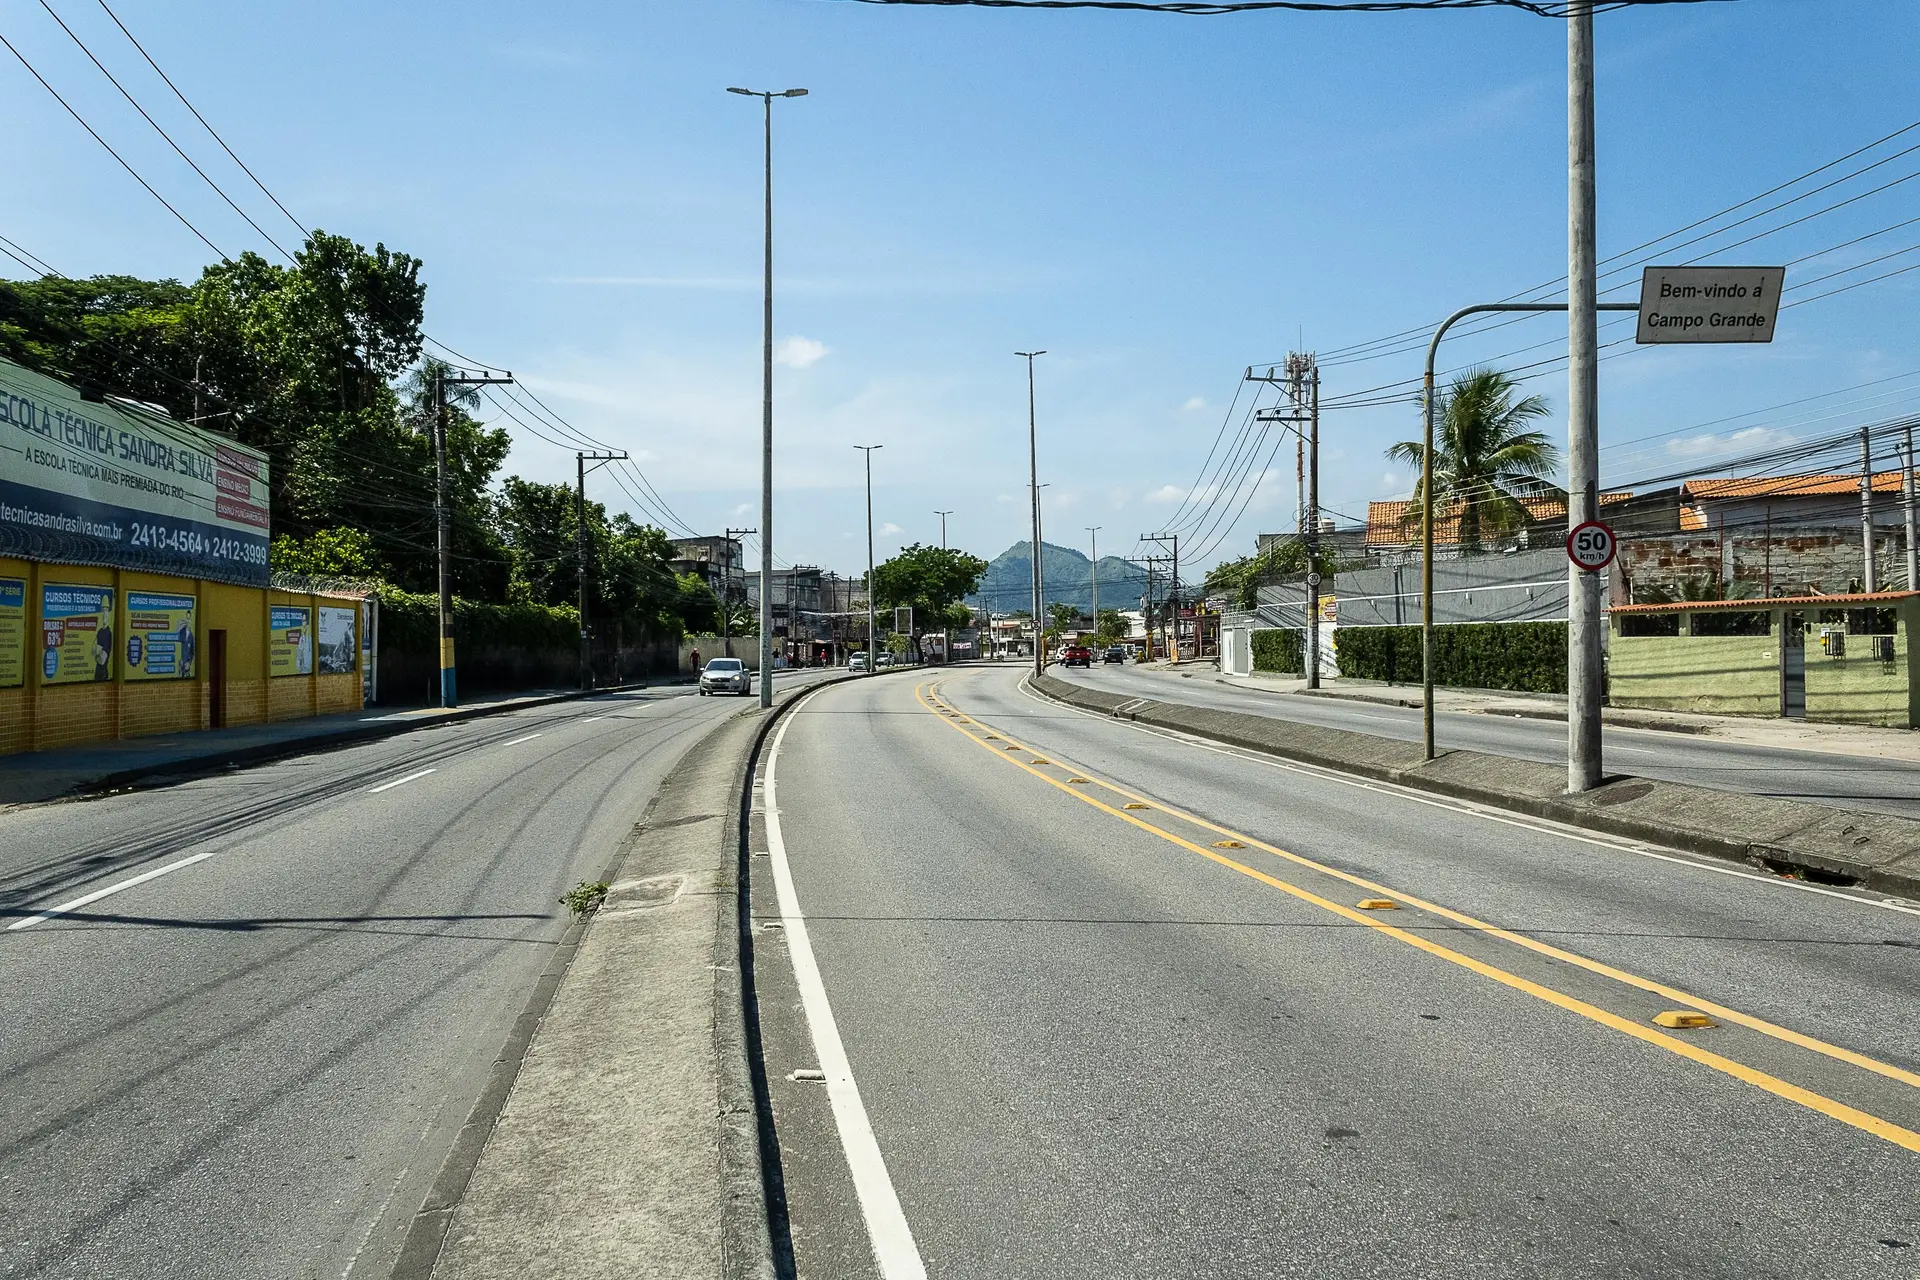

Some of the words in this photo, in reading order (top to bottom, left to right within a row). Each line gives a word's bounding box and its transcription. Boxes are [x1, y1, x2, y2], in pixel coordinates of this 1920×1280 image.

[1660, 283, 1747, 299] Bem-vindo
[1647, 312, 1704, 330] Campo
[1709, 312, 1766, 328] Grande
[55, 408, 115, 457] TÉCNICA
[119, 432, 175, 472] SANDRA
[180, 449, 213, 484] SILVA
[25, 447, 33, 462] A
[34, 449, 66, 470] ESCOLA
[68, 456, 100, 480] TÉCNICA
[101, 467, 119, 485] MAIS
[120, 473, 158, 494] PREMIADA
[159, 483, 171, 495] DO
[172, 486, 184, 499] RIO
[217, 476, 234, 490] ENSINO
[217, 503, 234, 516] ENSINO
[130, 522, 202, 554] 2413-4564
[212, 536, 267, 565] 2412-3999
[1578, 532, 1606, 551] 50
[1580, 552, 1604, 560] km/h
[45, 591, 72, 603] CURSOS
[73, 590, 102, 604] TÉCNICOS
[130, 597, 148, 605] CURSOS
[149, 598, 193, 608] PROFISSIONALIZANTES
[47, 632, 61, 646] 63%
